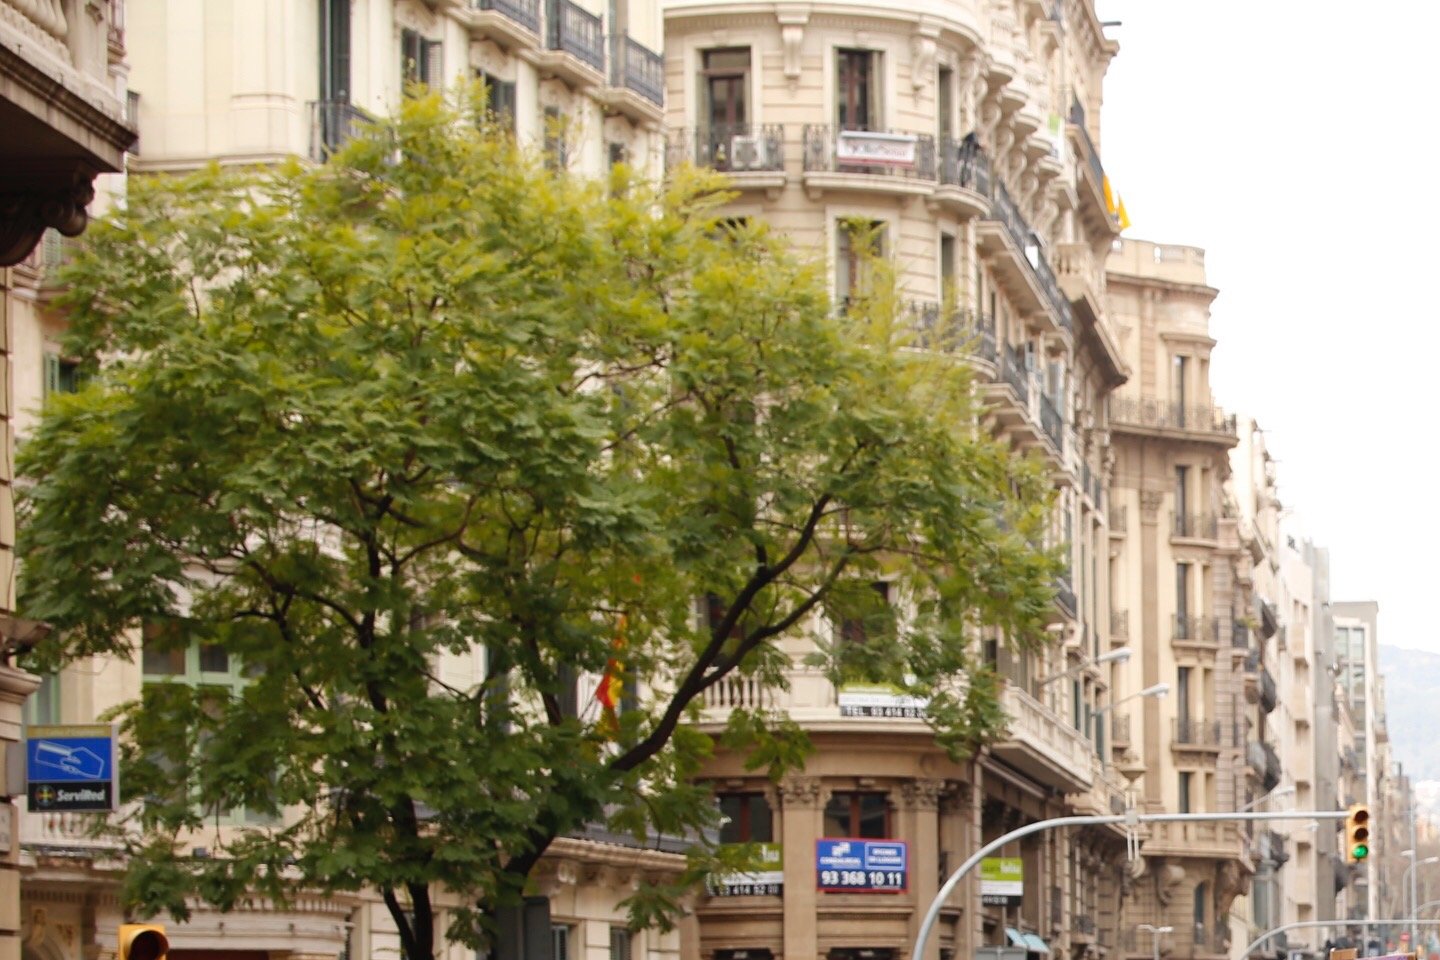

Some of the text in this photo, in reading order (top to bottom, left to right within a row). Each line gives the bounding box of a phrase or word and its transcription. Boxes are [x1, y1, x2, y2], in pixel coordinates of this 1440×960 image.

[822, 872, 902, 885] 93 368 10 11
